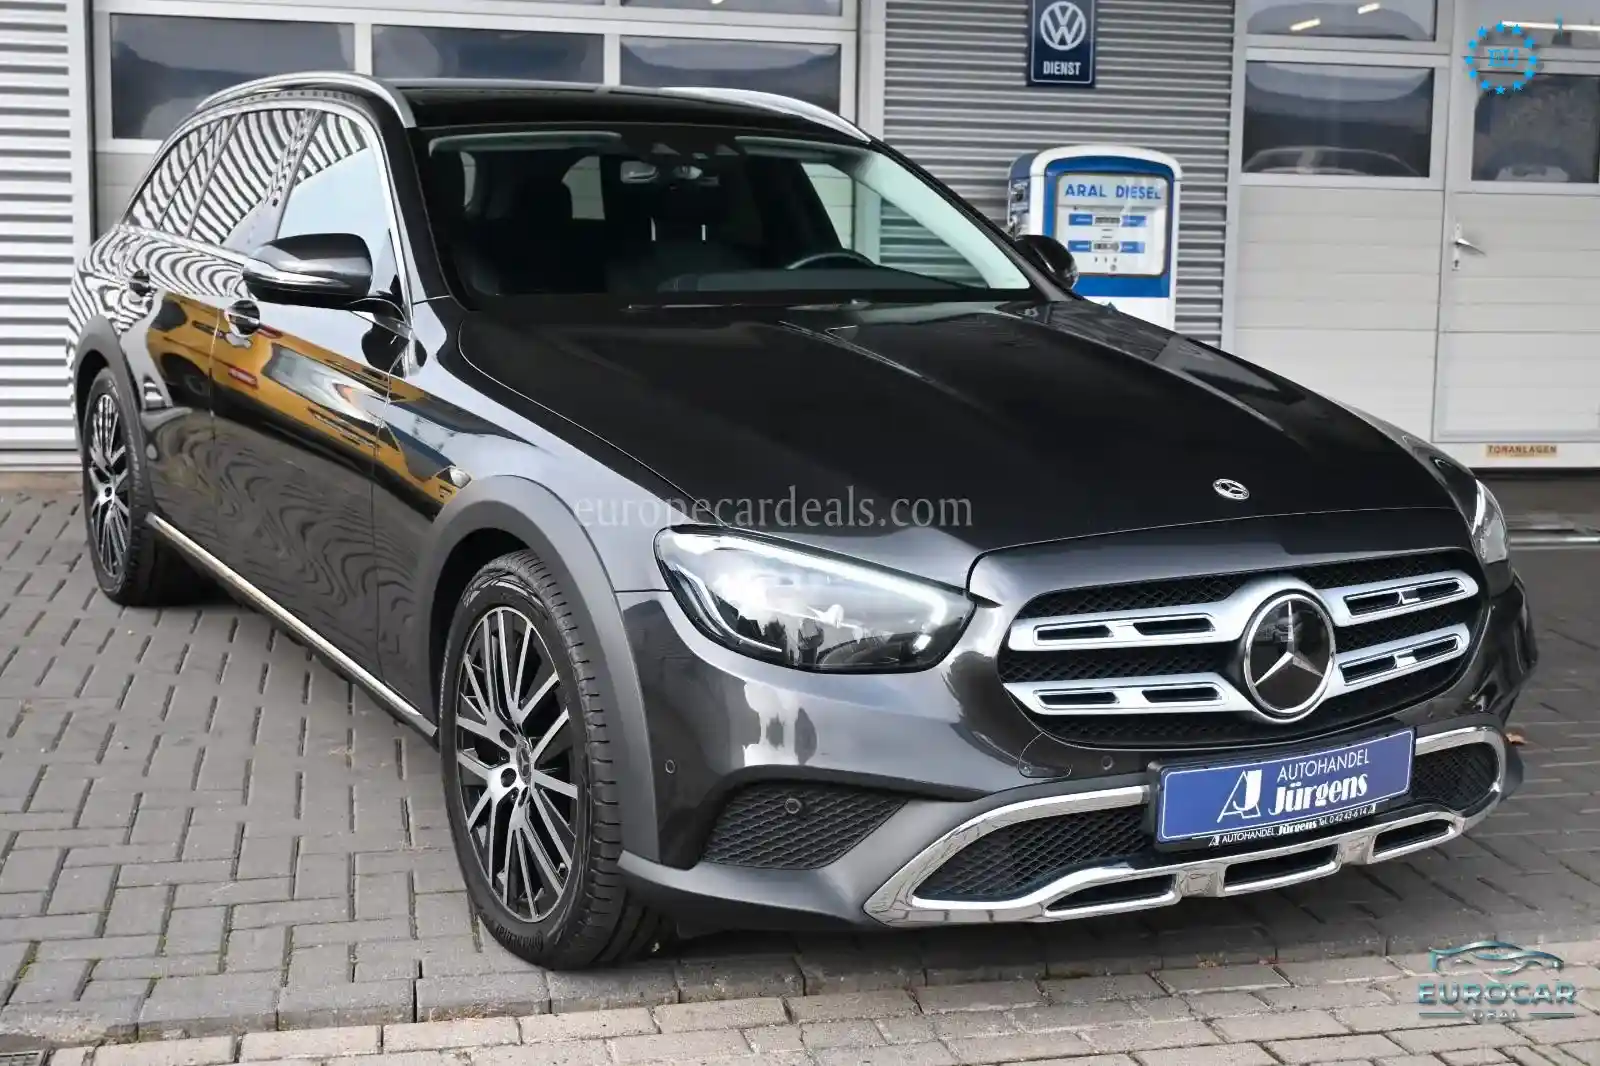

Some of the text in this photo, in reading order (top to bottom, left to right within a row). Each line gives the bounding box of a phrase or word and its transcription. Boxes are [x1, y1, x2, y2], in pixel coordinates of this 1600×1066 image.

[1040, 1, 1087, 50] VW
[1043, 61, 1081, 75] DIENST
[1065, 184, 1161, 200] ARAL DIESEL
[1487, 445, 1557, 454] TORANLAGEN
[1277, 748, 1370, 783] AUTOHANDEL
[1267, 773, 1368, 815] Jürgens
[1221, 827, 1276, 844] AUTOHANDEL
[1277, 820, 1318, 836] Jürgens
